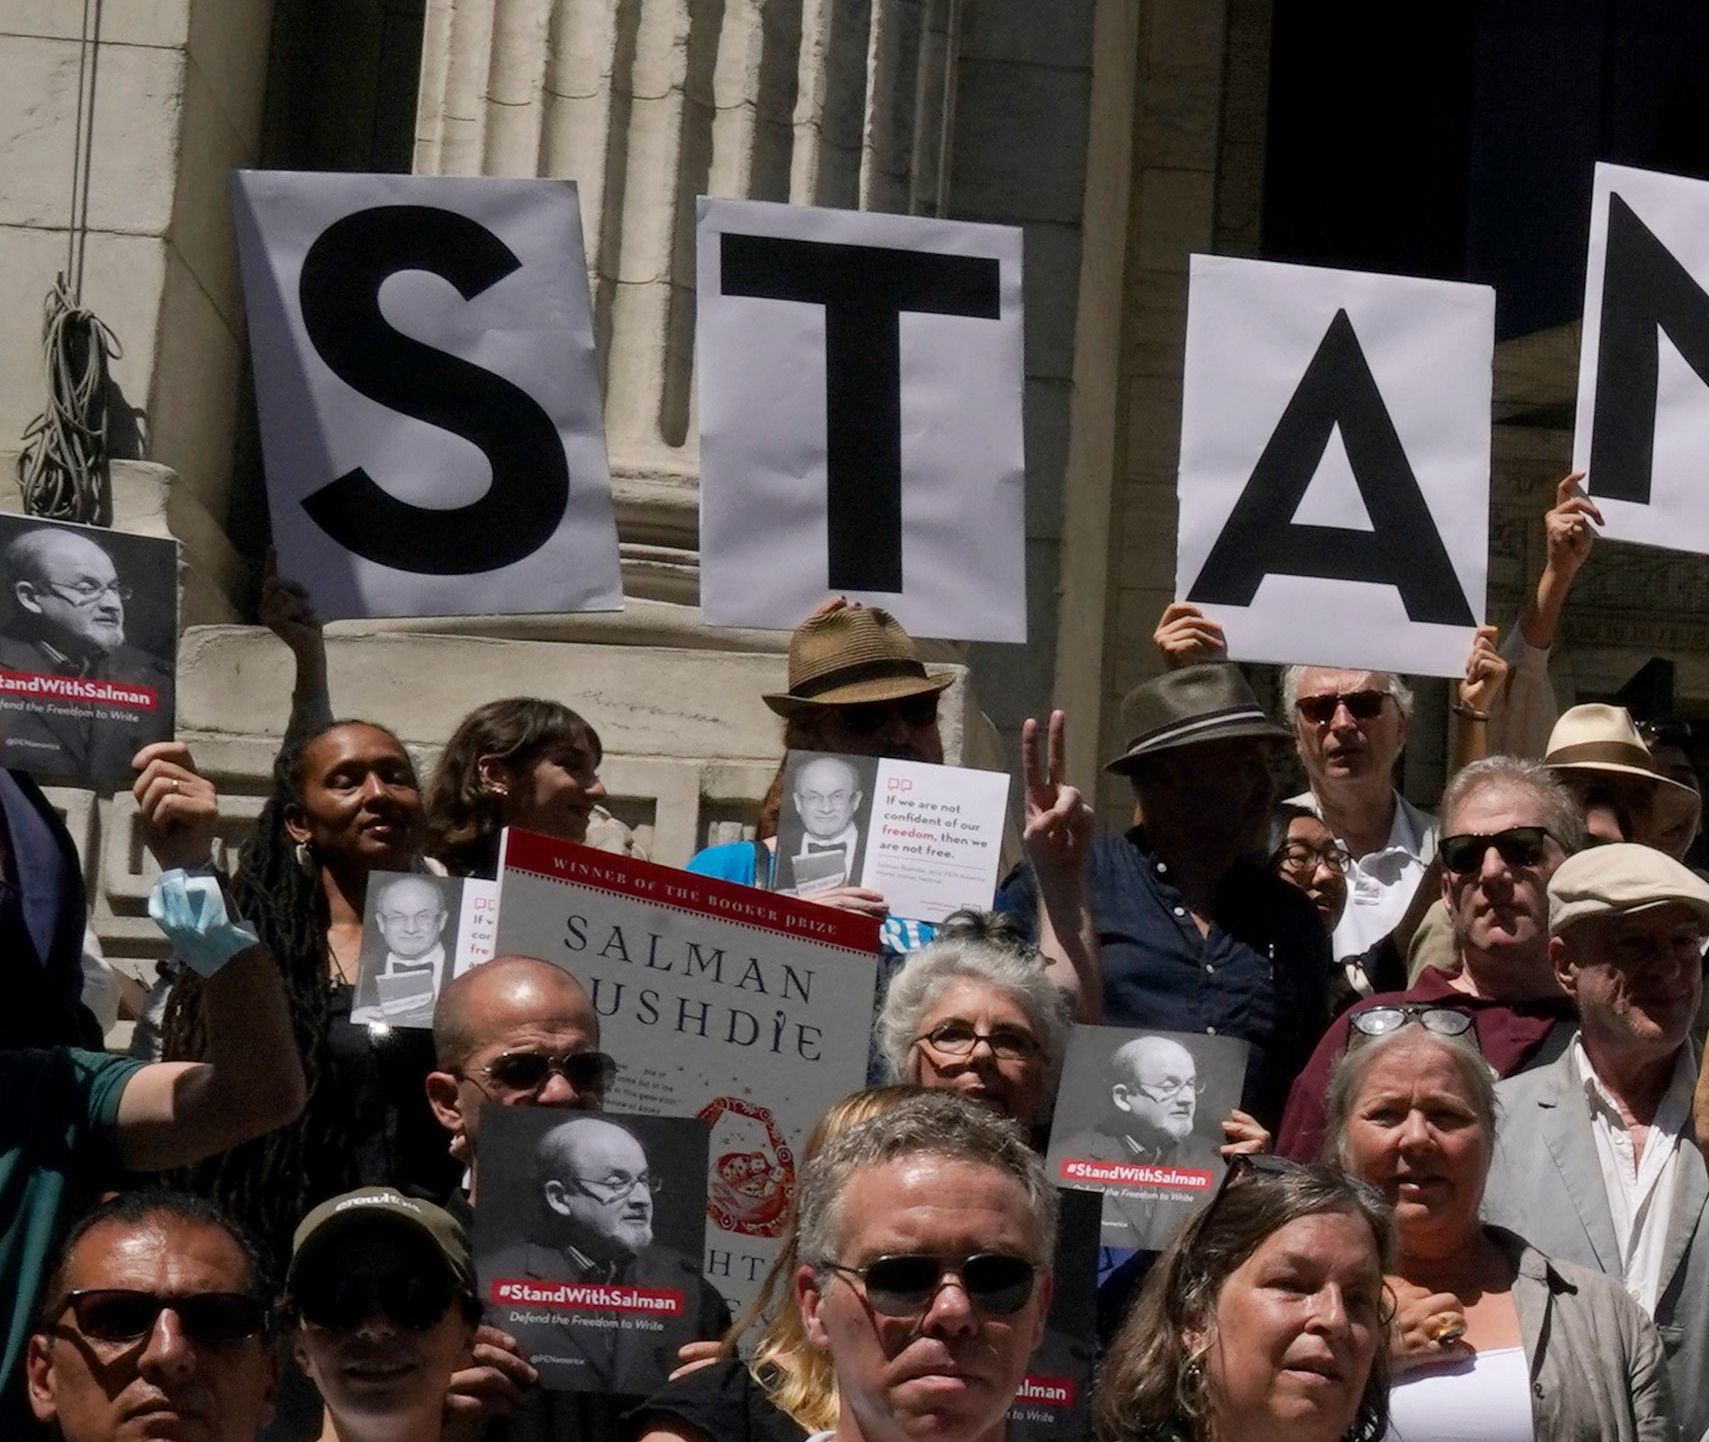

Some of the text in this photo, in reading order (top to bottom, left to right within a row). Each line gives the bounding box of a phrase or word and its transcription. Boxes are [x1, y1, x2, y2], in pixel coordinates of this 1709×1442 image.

[0, 675, 150, 704] tandWithSalman
[940, 803, 961, 814] not
[883, 812, 981, 832] confident our
[902, 844, 922, 855] not
[941, 833, 968, 846] then
[553, 856, 627, 886] WINNER
[665, 885, 699, 901] THE
[708, 894, 778, 922] BOOKER
[564, 914, 815, 1004] SALMAN
[592, 977, 823, 1061] USHDIE
[1066, 1163, 1207, 1187] #StandWithSalman
[499, 1284, 676, 1310] #StandWithSalman
[509, 1311, 665, 1332] Defend the Freedom Write
